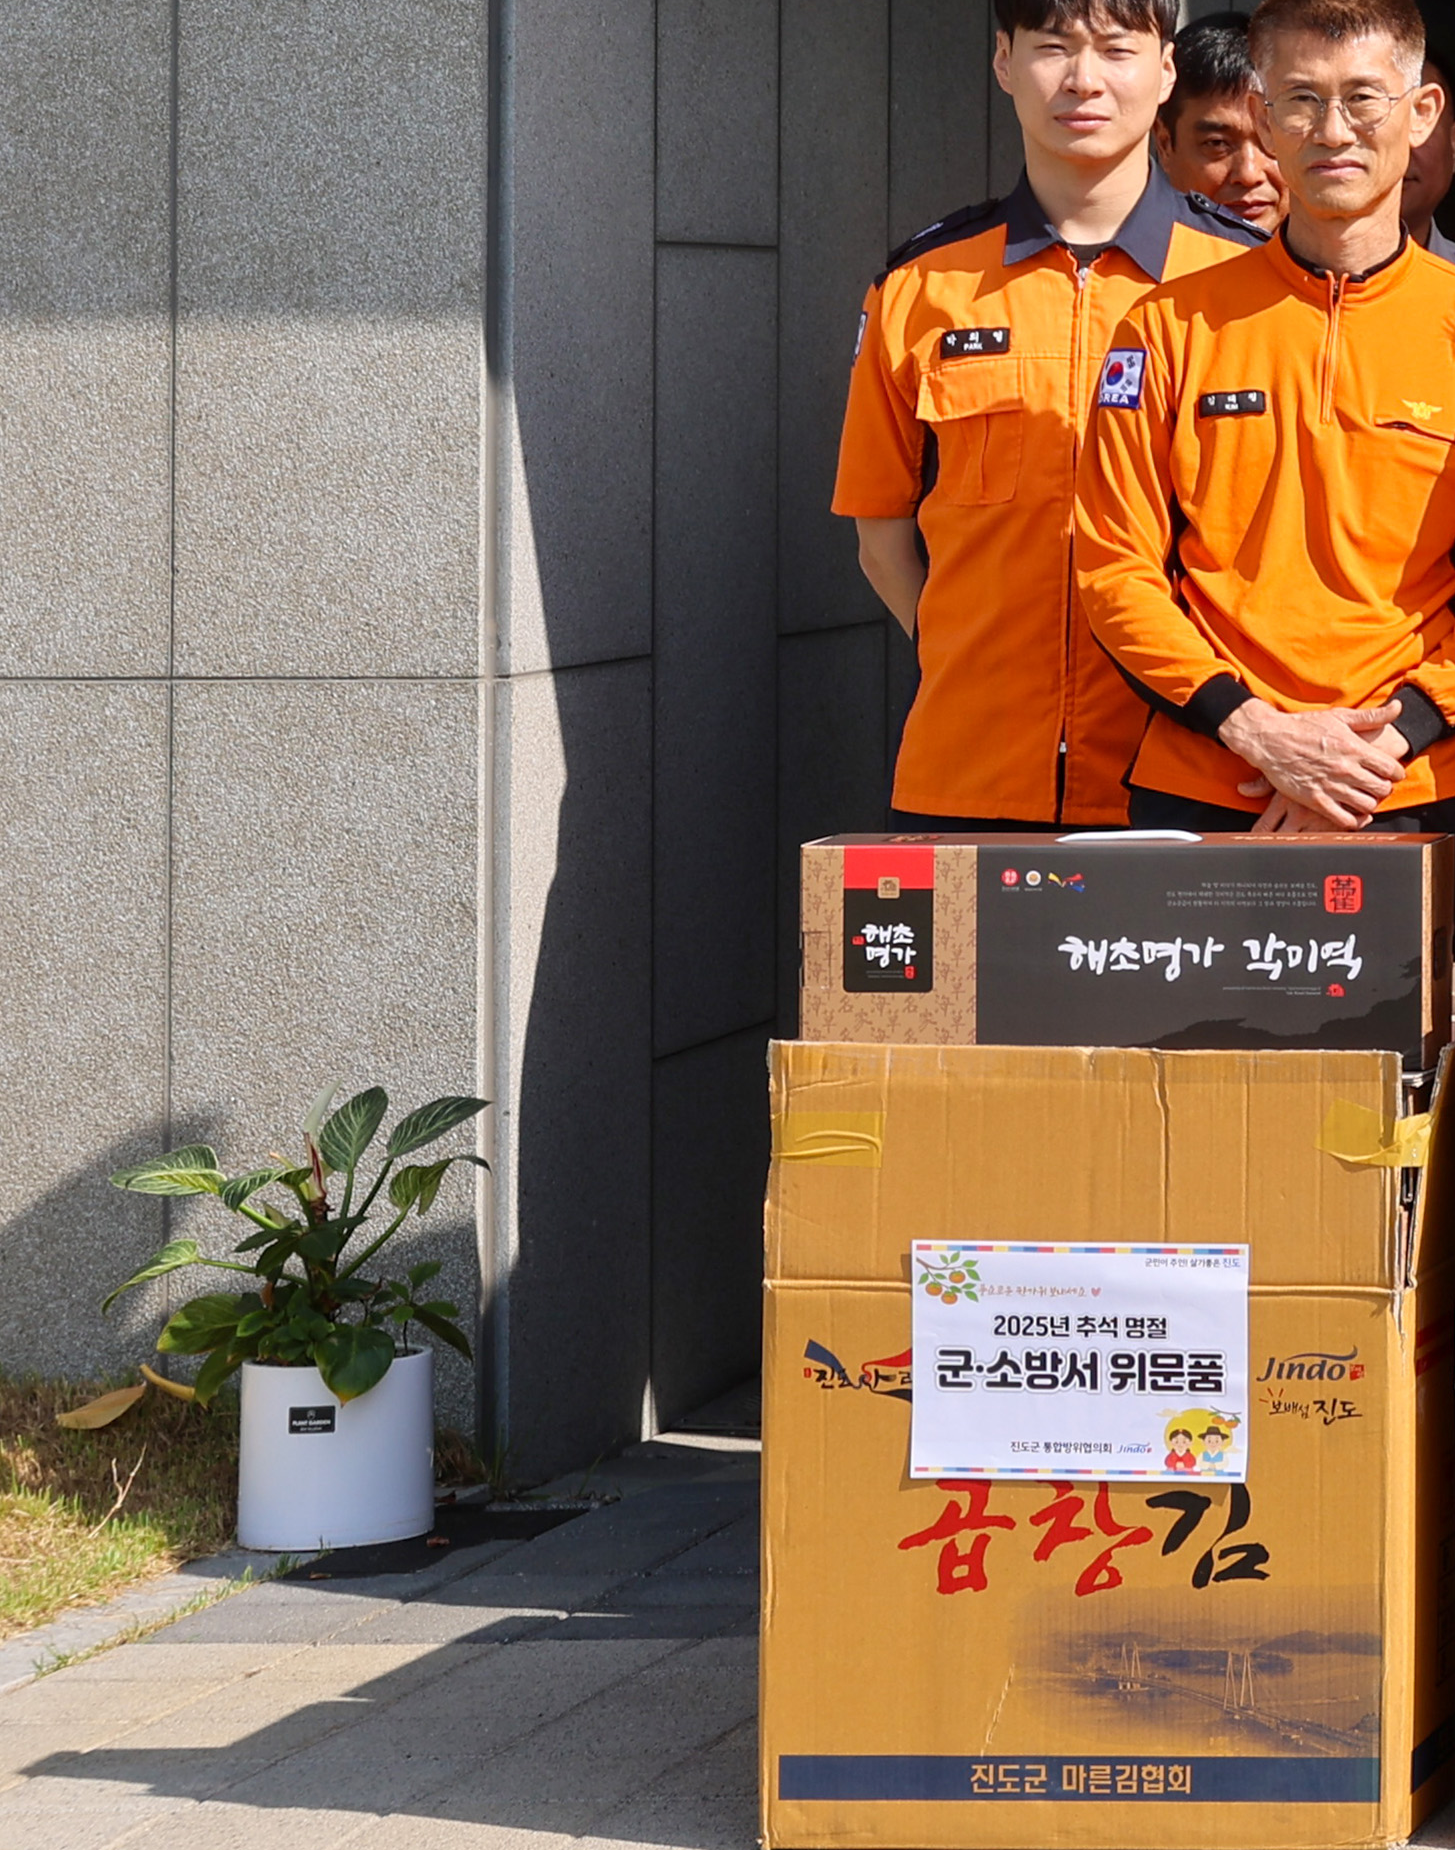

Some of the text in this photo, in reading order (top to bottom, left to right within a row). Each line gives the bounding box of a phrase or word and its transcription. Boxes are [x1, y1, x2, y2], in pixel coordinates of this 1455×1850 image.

[861, 923, 914, 946] 해초
[866, 945, 916, 967] 명가
[1058, 936, 1224, 981] 해초명가
[1222, 1257, 1241, 1269] 진도
[994, 1315, 1166, 1338] 2025년 추석 명절
[938, 1350, 1097, 1390] 군·소방서
[1110, 1353, 1223, 1392] 위문품
[1256, 1354, 1347, 1382] Jindo
[1313, 1398, 1363, 1426] 진도
[1010, 1441, 1040, 1453] 진도군
[1043, 1441, 1113, 1454] 통합방위협의회
[898, 1481, 1269, 1597] 곱창김
[970, 1764, 1191, 1795] 진도군 마른김협회
